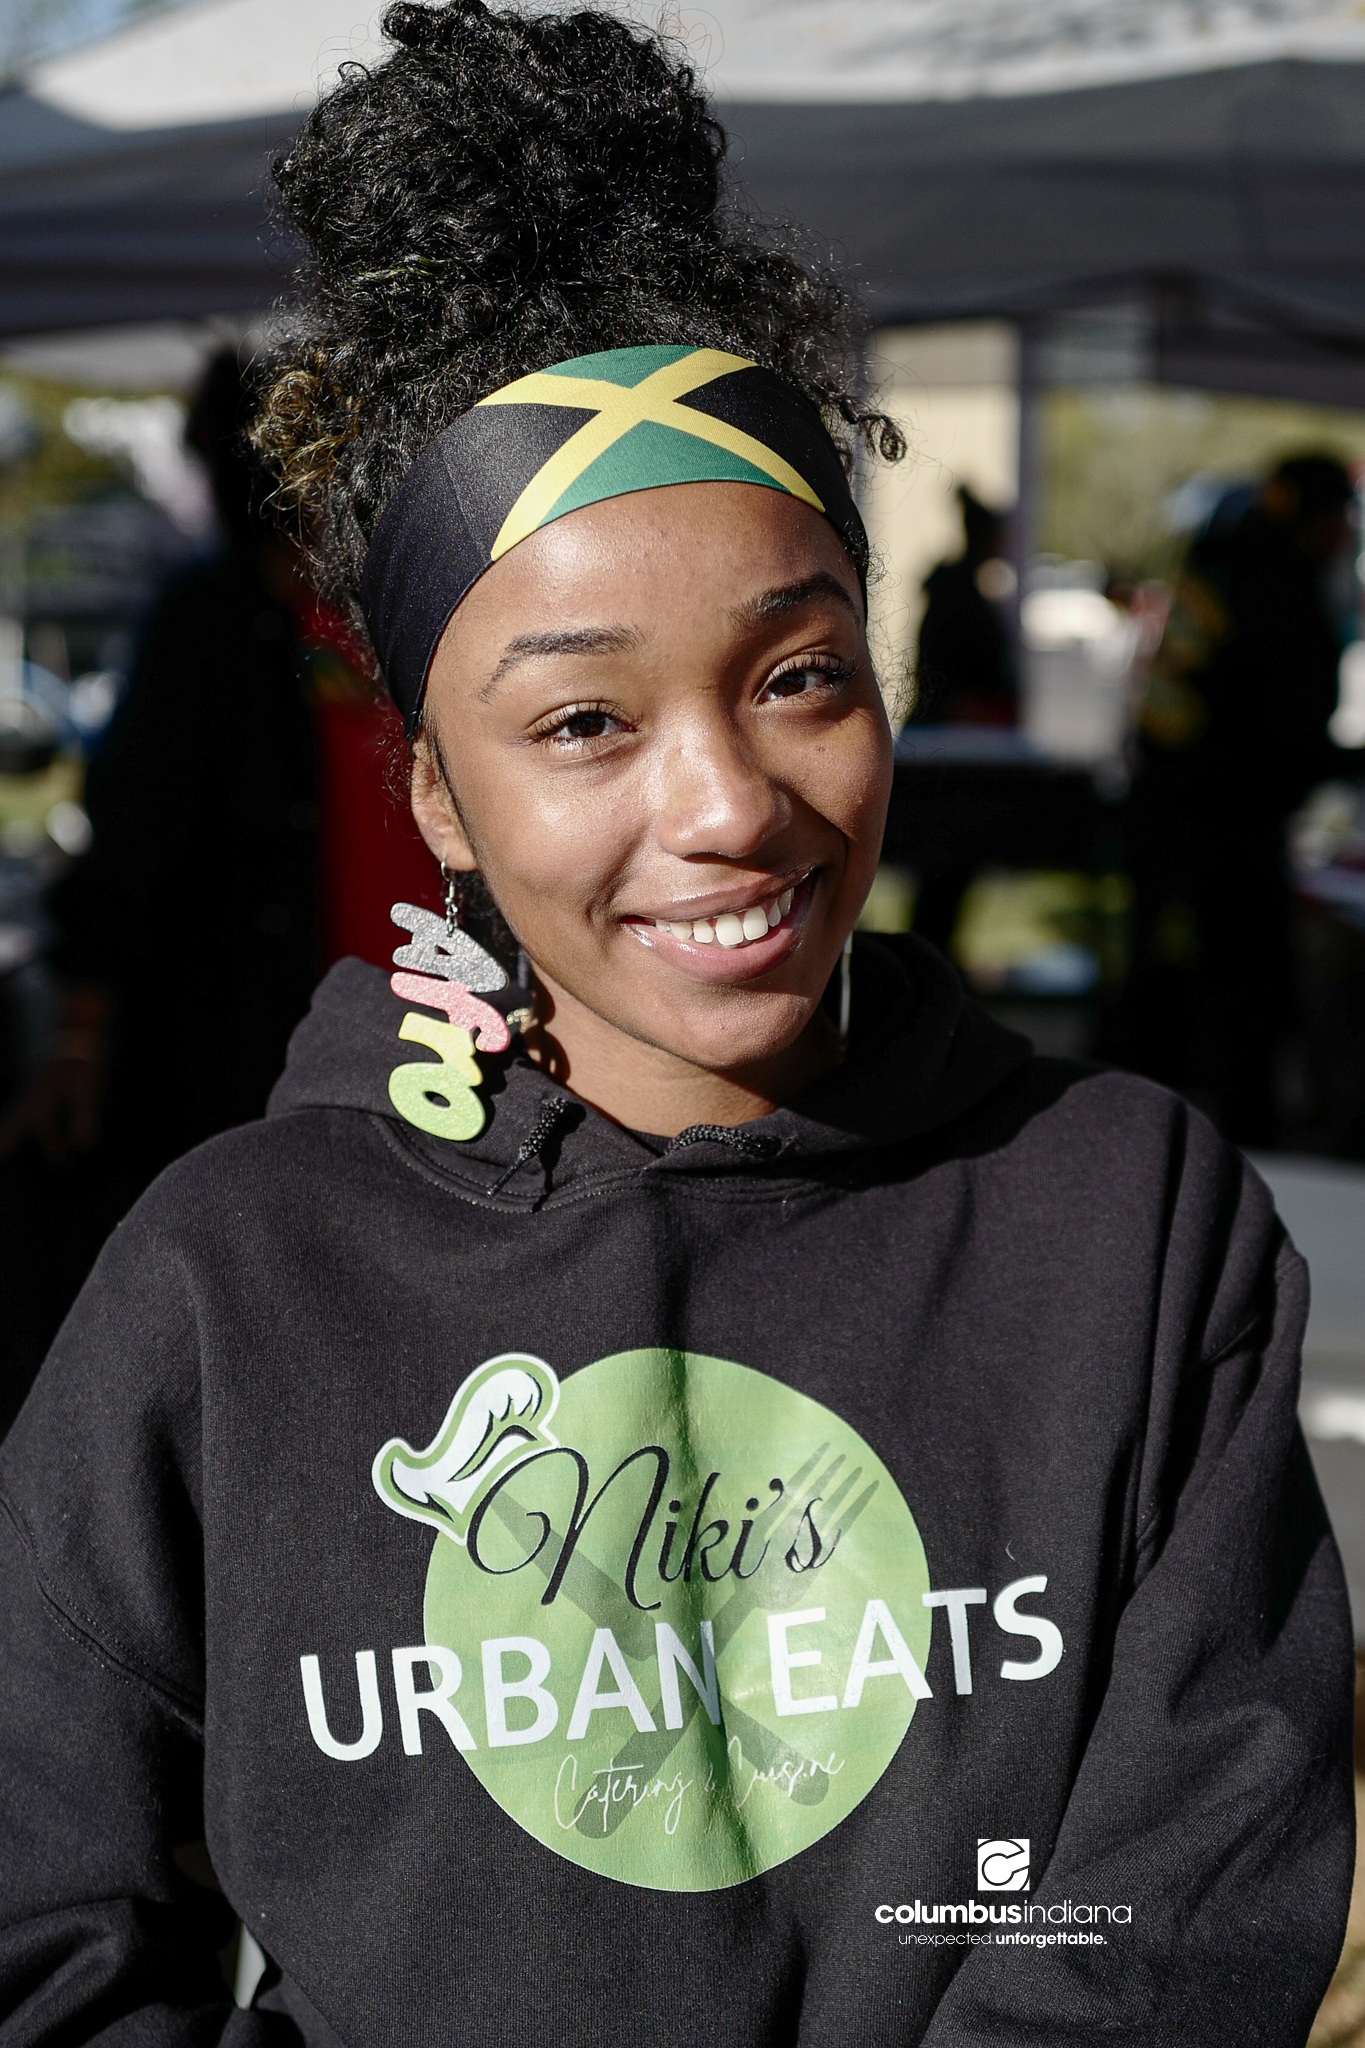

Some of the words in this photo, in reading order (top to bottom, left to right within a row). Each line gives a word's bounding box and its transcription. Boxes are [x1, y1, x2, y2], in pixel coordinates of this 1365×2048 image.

[466, 1444, 842, 1610] Niki's
[299, 1620, 722, 1762] URBAN
[766, 1574, 1065, 1717] EATS
[554, 1753, 694, 1835] Catering
